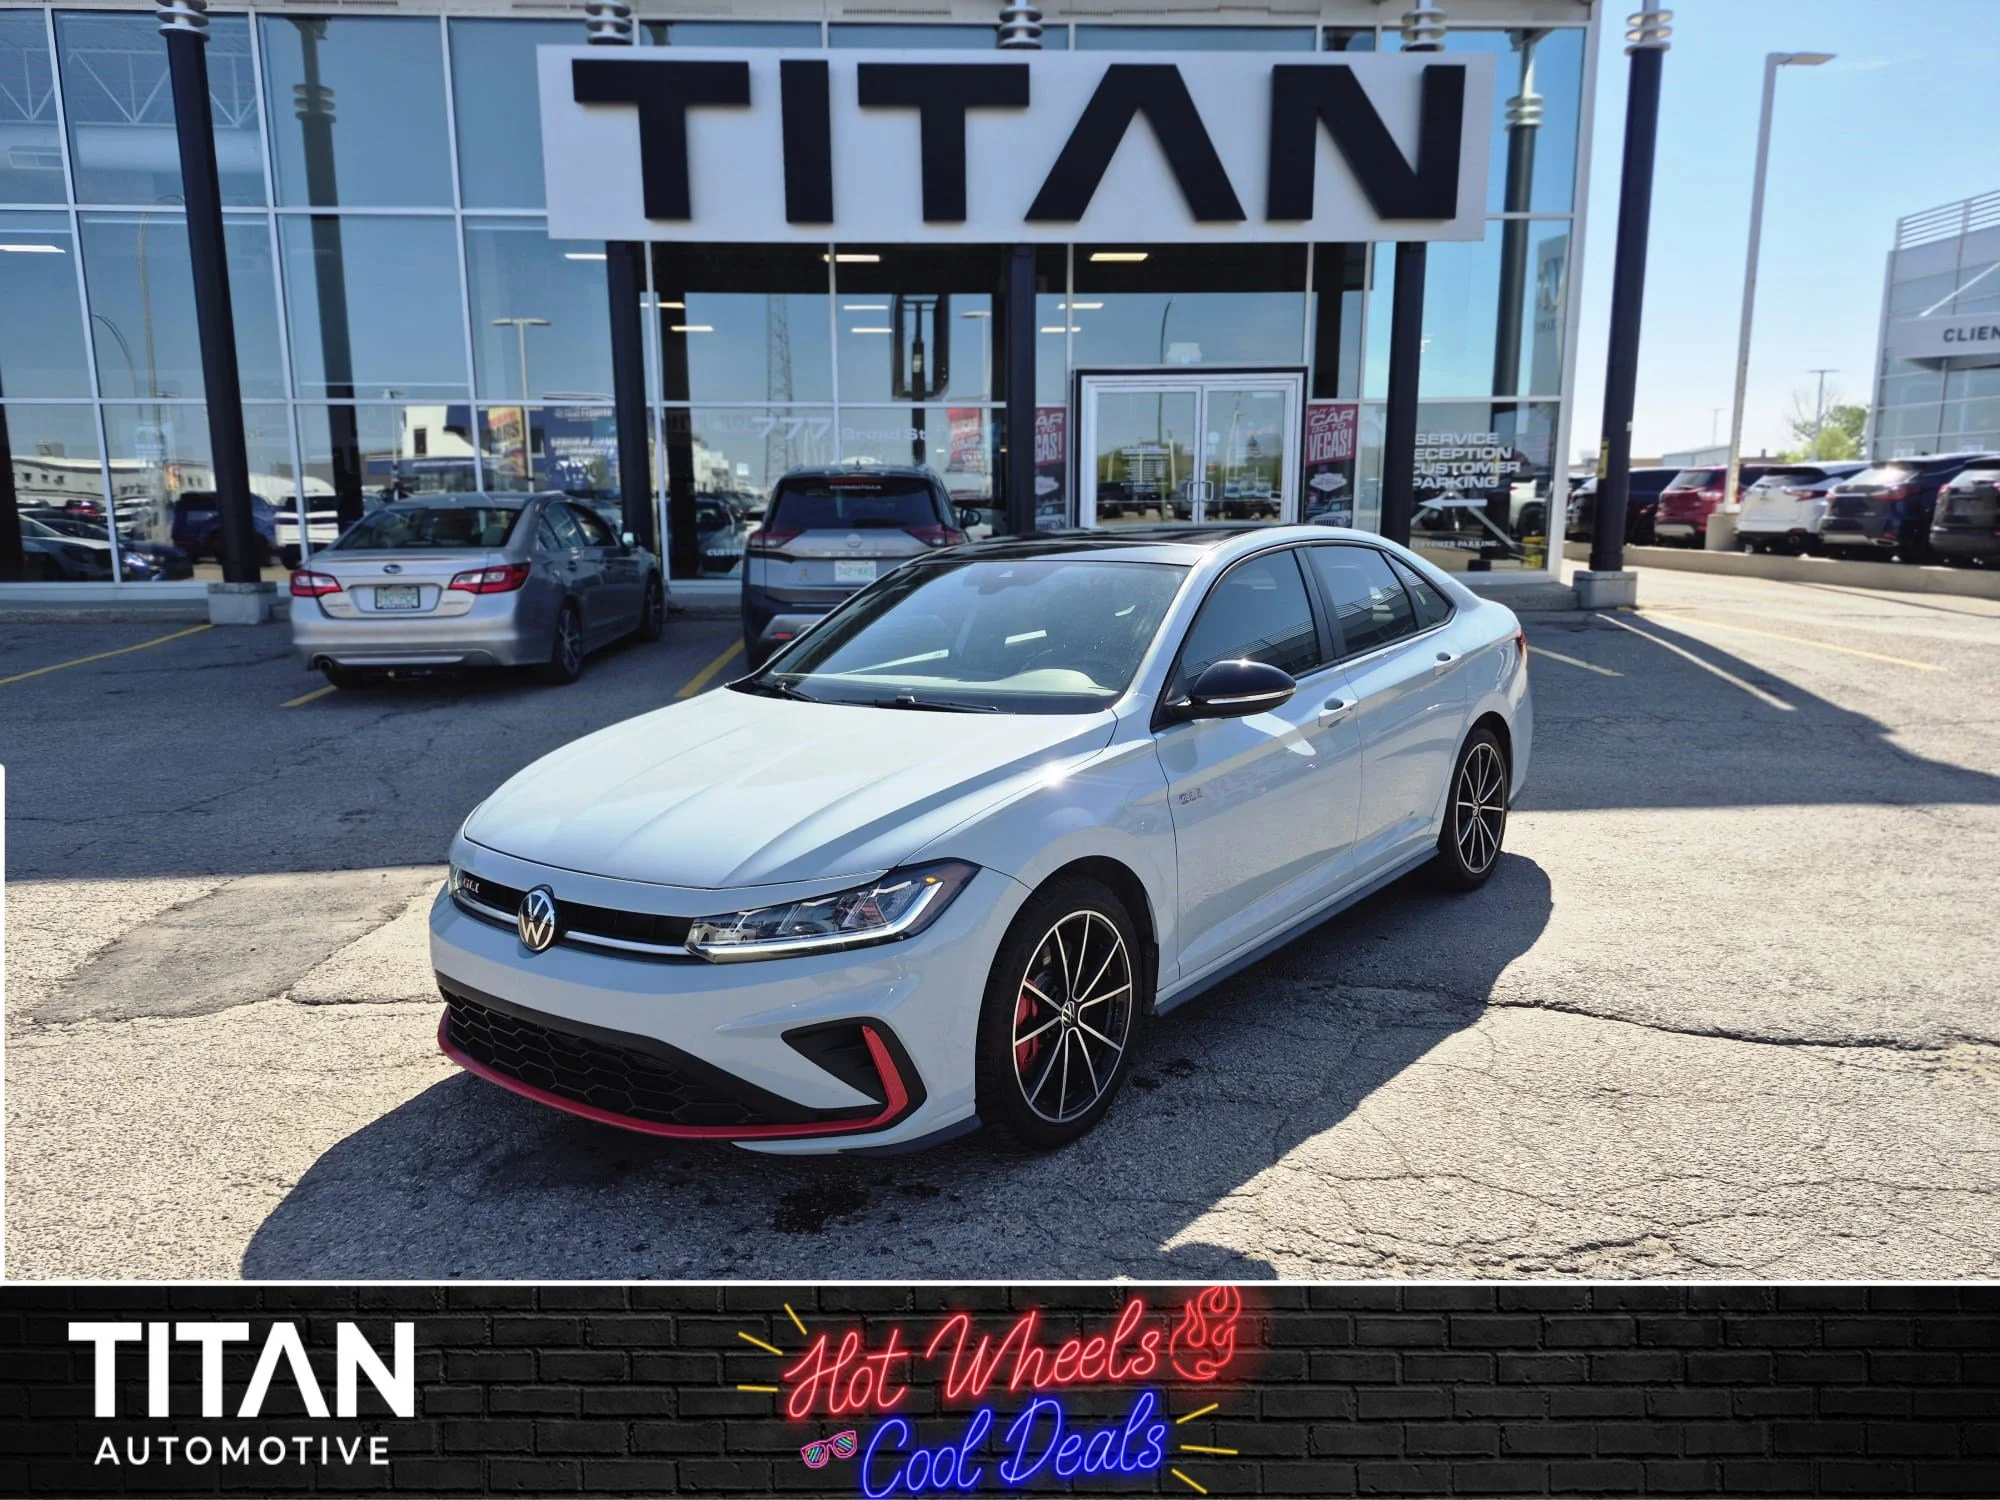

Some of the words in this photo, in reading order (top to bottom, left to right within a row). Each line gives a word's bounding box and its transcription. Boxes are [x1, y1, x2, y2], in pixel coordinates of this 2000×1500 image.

[571, 58, 1466, 223] TITAN
[1943, 325, 2000, 343] CLIEN
[1036, 413, 1064, 427] AR
[1310, 409, 1355, 426] CAR
[752, 416, 833, 440] 777
[1036, 431, 1063, 463] GAS!
[1309, 428, 1352, 462] VEGAS!
[1416, 432, 1500, 445] SERVICE
[1414, 446, 1512, 461] ECEPTION
[1412, 475, 1500, 489] PARKING
